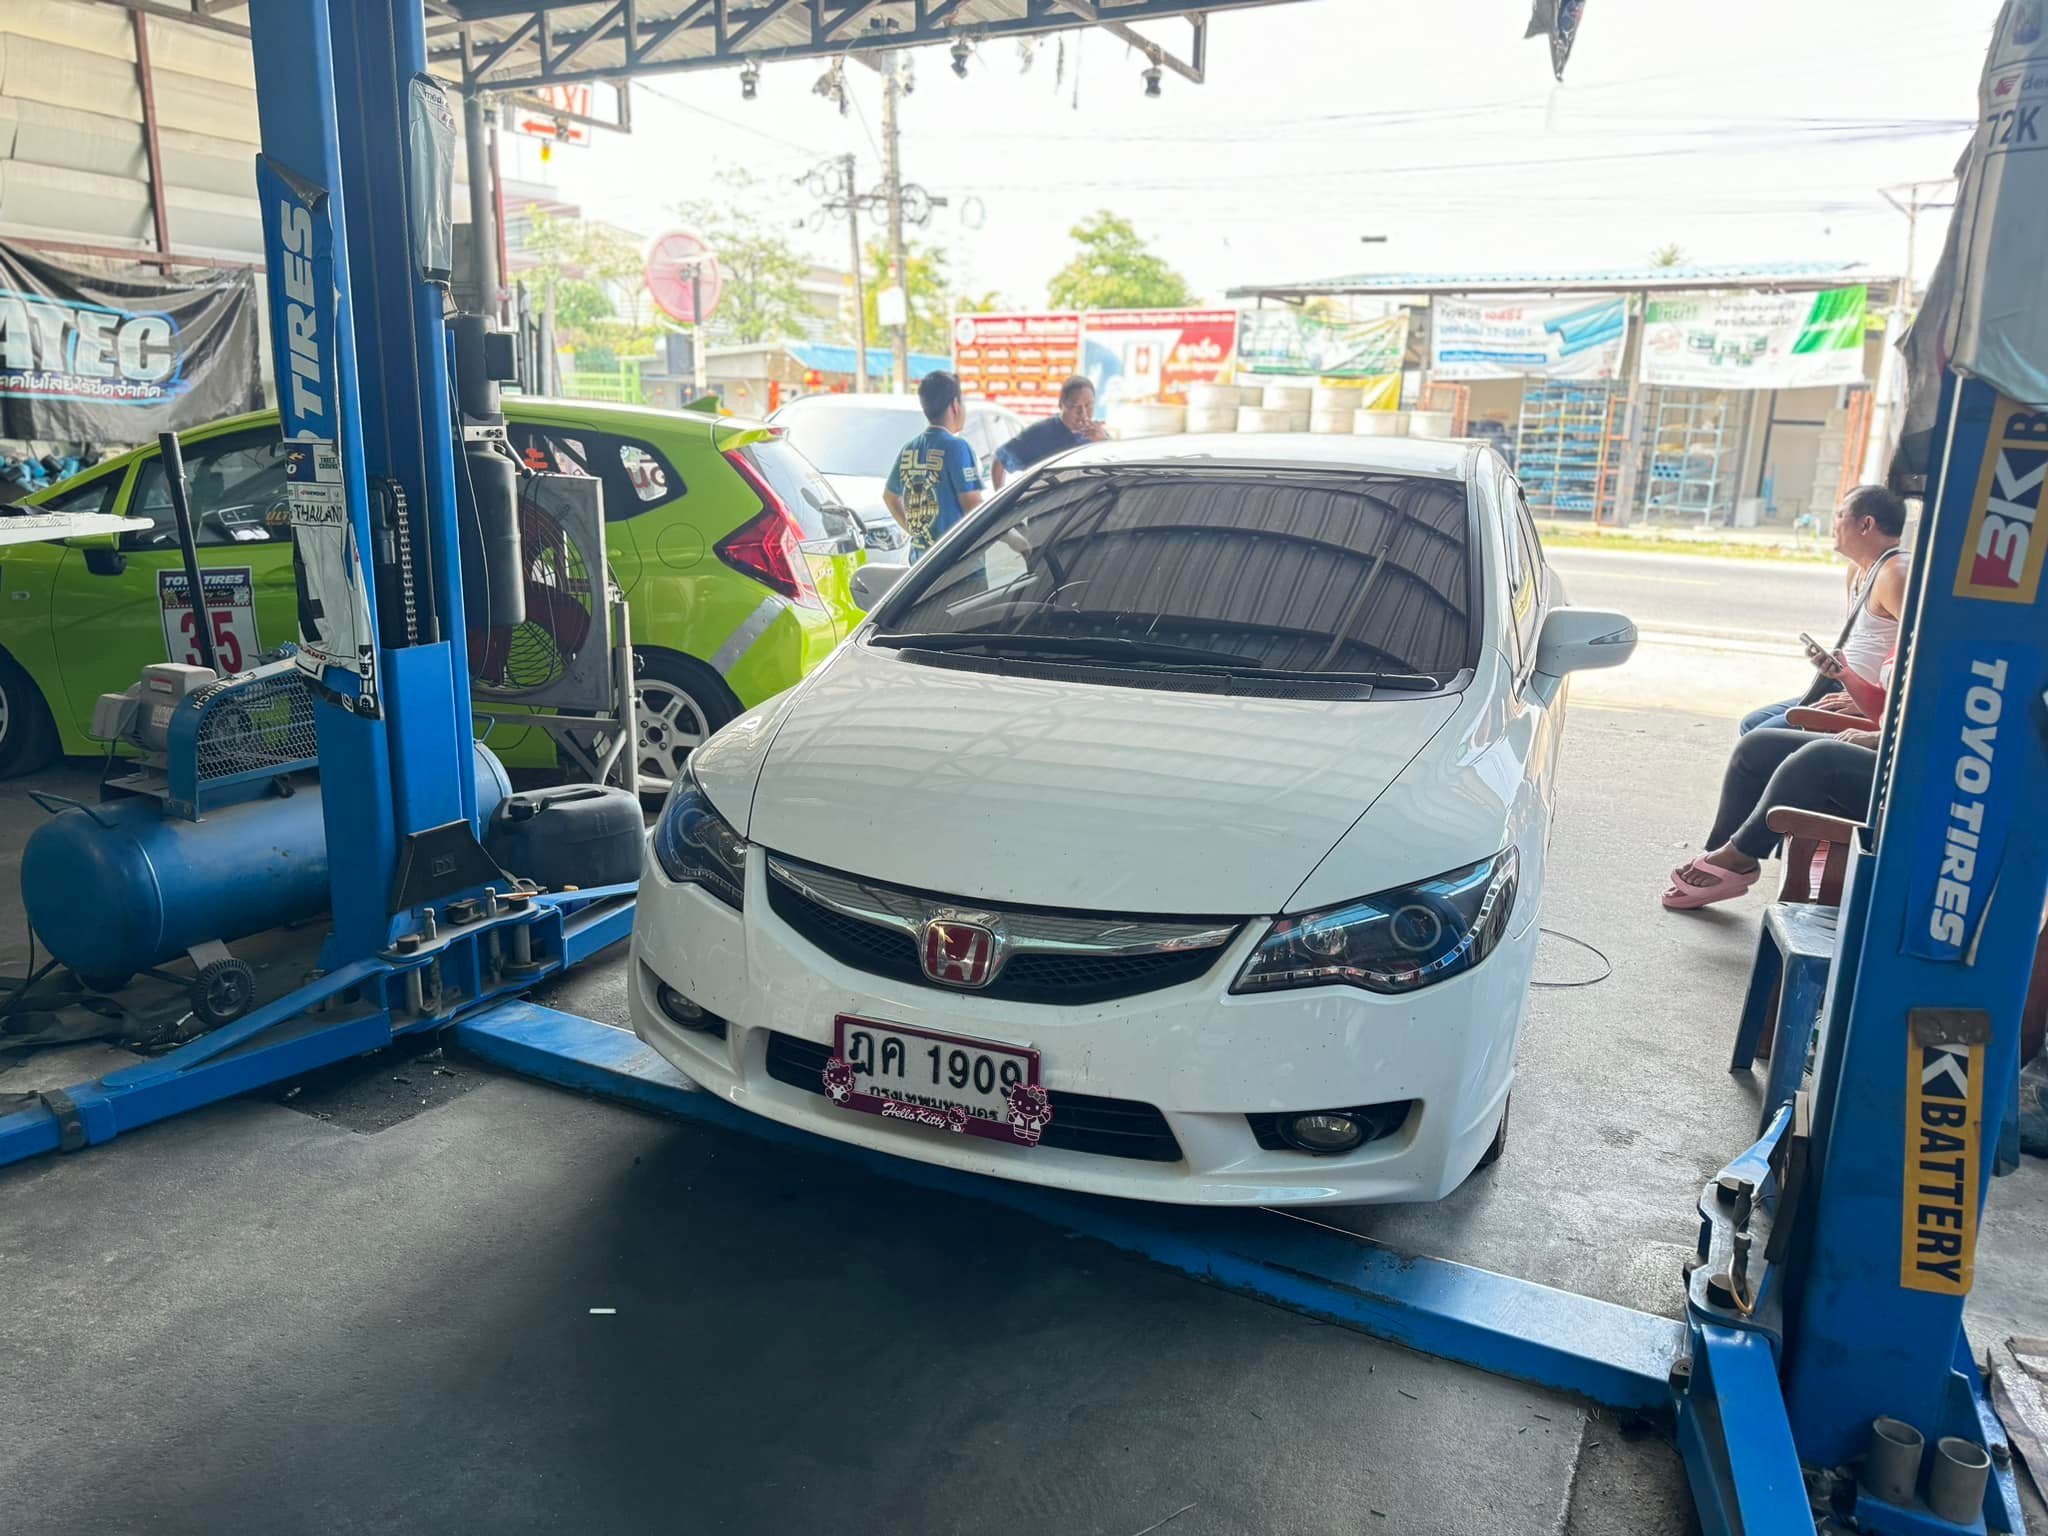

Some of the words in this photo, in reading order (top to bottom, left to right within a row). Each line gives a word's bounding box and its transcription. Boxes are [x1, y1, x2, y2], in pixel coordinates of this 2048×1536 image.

[1986, 106, 2041, 148] 72K
[281, 200, 323, 419] TIRES
[203, 574, 245, 585] TIRES
[181, 611, 242, 674] 35
[1954, 658, 2009, 795] TOYO
[1929, 801, 1985, 947] TIRES
[927, 1045, 1023, 1098] 1909
[882, 1101, 916, 1121] Hello
[916, 1109, 947, 1129] Kitty
[1916, 1101, 1967, 1284] BATTERY
